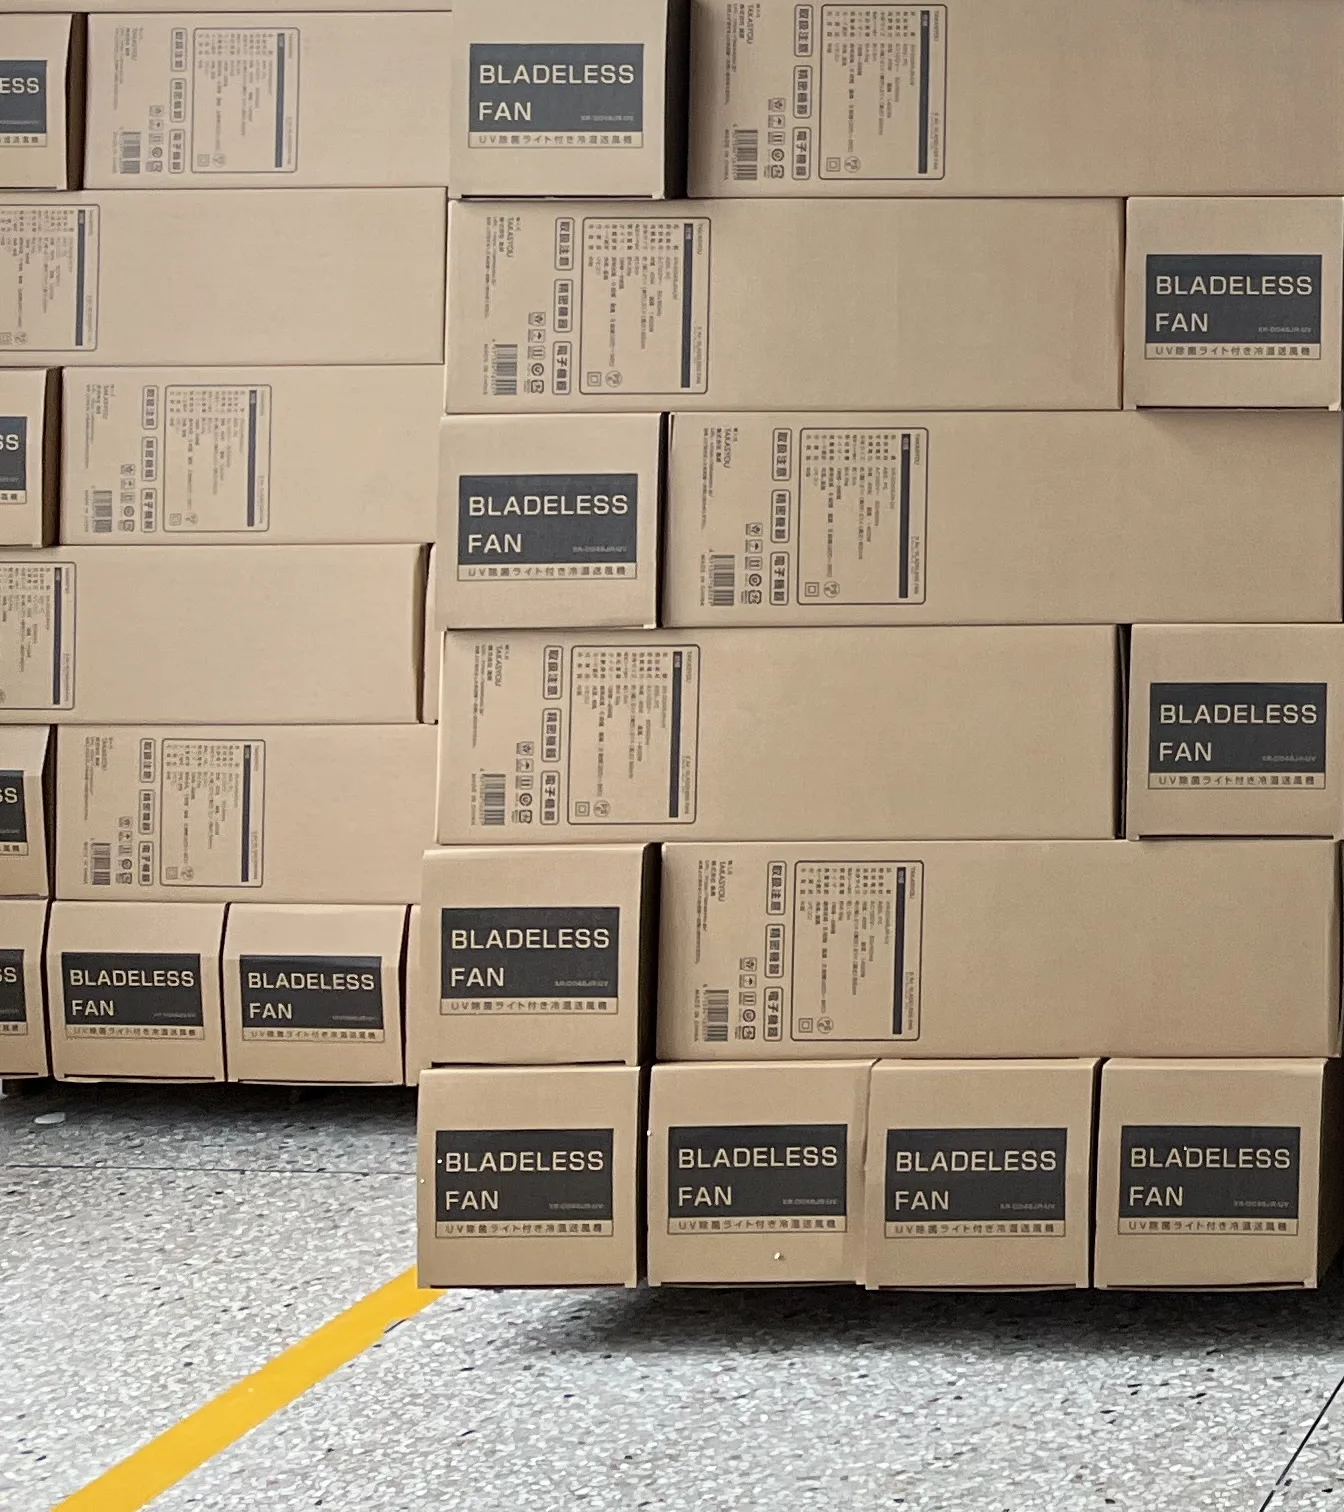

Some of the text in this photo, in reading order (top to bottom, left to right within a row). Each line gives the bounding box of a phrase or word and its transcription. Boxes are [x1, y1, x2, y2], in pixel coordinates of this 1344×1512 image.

[798, 9, 808, 52] 取扱注意
[480, 65, 633, 83] BLADELESS
[480, 102, 530, 120] FAN
[796, 131, 807, 175] 電子機器
[559, 222, 570, 266] 取扱注意
[1157, 276, 1312, 295] BLADELESS
[1156, 313, 1207, 331] FAN
[556, 346, 567, 390] 電子機器
[776, 432, 788, 476] 取扱注意
[470, 495, 627, 515] BLADELESS
[469, 534, 521, 553] FAN
[774, 556, 785, 601] 電子機器
[547, 650, 559, 695] 取扱注意
[1161, 705, 1316, 723] BLADELESS
[1160, 742, 1211, 761] FAN
[545, 775, 556, 820] 電子機器
[771, 865, 782, 910] 取扱注意
[452, 929, 609, 949] BLADELESS
[70, 970, 194, 986] BLADELESS
[249, 973, 374, 990] BLADELESS
[452, 968, 503, 986] FAN
[72, 1000, 113, 1015] FAN
[250, 1003, 291, 1018] FAN
[768, 991, 779, 1037] 電子機器
[446, 1151, 603, 1171] BLADELESS
[679, 1147, 837, 1168] BLADELESS
[897, 1151, 1056, 1171] BLADELESS
[1131, 1147, 1290, 1168] BLADELESS
[446, 1191, 498, 1209] FAN
[679, 1187, 731, 1206] FAN
[896, 1191, 948, 1209] FAN
[1130, 1187, 1182, 1206] FAN
